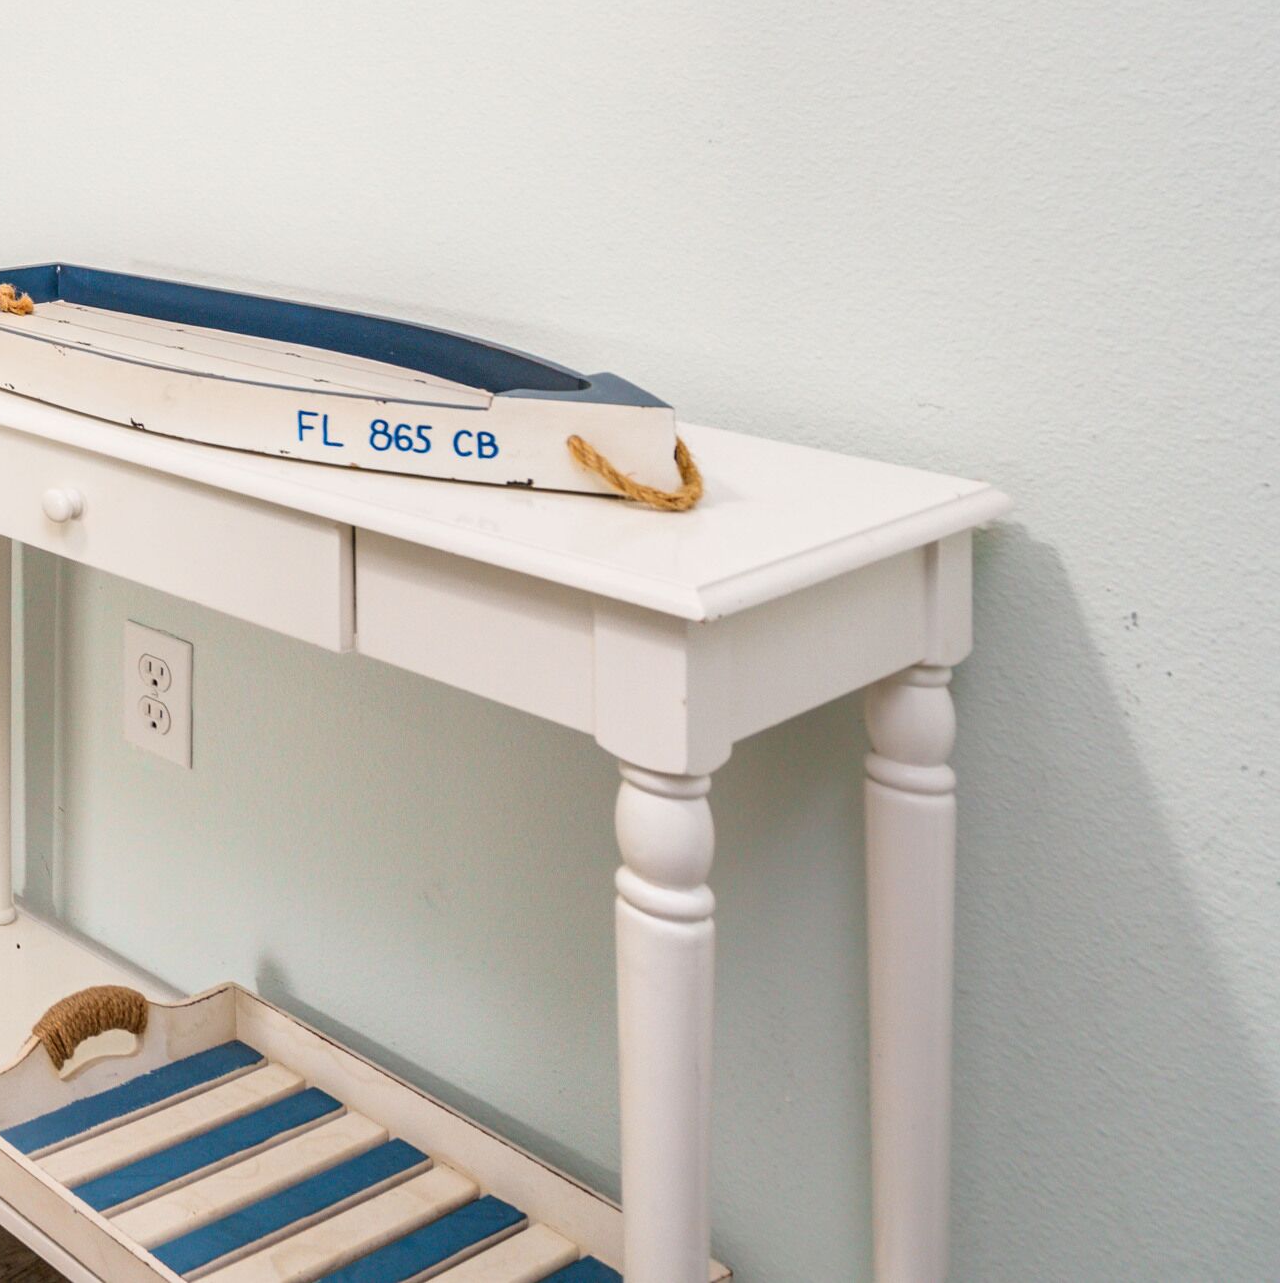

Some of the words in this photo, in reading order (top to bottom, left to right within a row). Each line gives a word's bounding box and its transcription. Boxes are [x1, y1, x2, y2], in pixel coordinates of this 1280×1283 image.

[297, 410, 345, 448] FL
[369, 418, 433, 454] 865
[452, 429, 500, 460] CB
